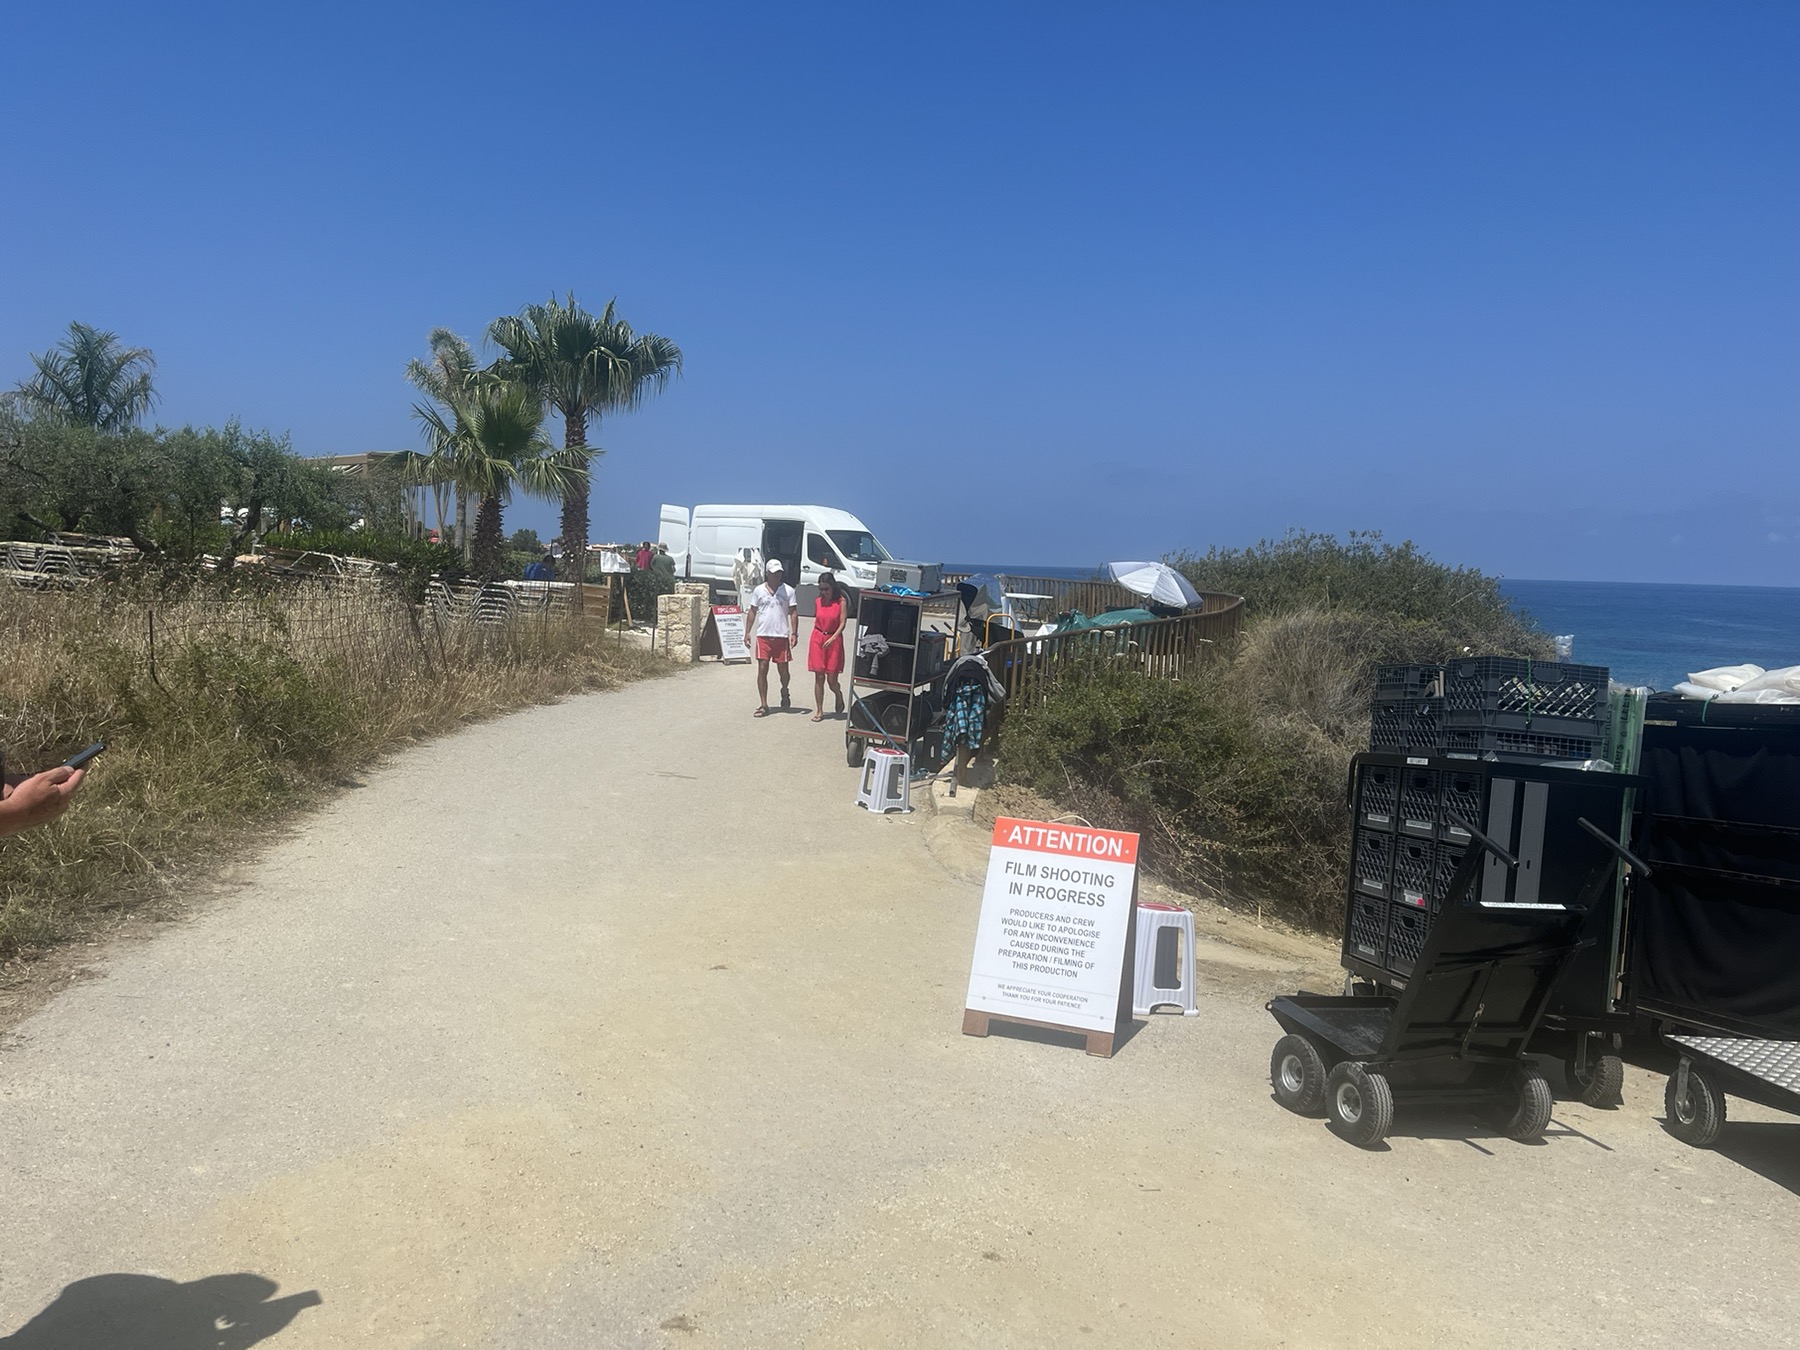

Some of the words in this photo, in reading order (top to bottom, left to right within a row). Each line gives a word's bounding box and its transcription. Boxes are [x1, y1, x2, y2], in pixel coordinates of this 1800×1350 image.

[1008, 826, 1122, 857] ATTENTION
[1005, 861, 1036, 877] FILM
[1040, 866, 1115, 888] SHOOTING
[1009, 882, 1022, 895] IN
[1026, 884, 1105, 907] PROGRESS
[1010, 908, 1054, 921] PRODUCERS
[1055, 916, 1071, 924] AND
[1072, 918, 1095, 927] CREW
[1001, 918, 1027, 928] WOULD
[1029, 922, 1045, 930] LIKE
[1047, 924, 1056, 932] TO
[1058, 926, 1100, 938] APOLOGISE
[1004, 928, 1018, 937] FOR
[1020, 931, 1034, 939] ANY
[1036, 933, 1095, 948] INCONVENIENCE
[998, 948, 1048, 962] PREPARATION
[1054, 957, 1083, 968] FILMING
[1084, 962, 1095, 970] OF
[1010, 940, 1040, 950] CAUSED
[1041, 944, 1069, 956] DURING
[1072, 949, 1086, 958] THE
[1012, 961, 1028, 970] THIS
[1030, 964, 1078, 978] PRODUCTION
[1006, 986, 1036, 994] APPRECIATE
[1052, 992, 1088, 1002] COOPERATION
[1057, 1000, 1081, 1009] PATIENCE
